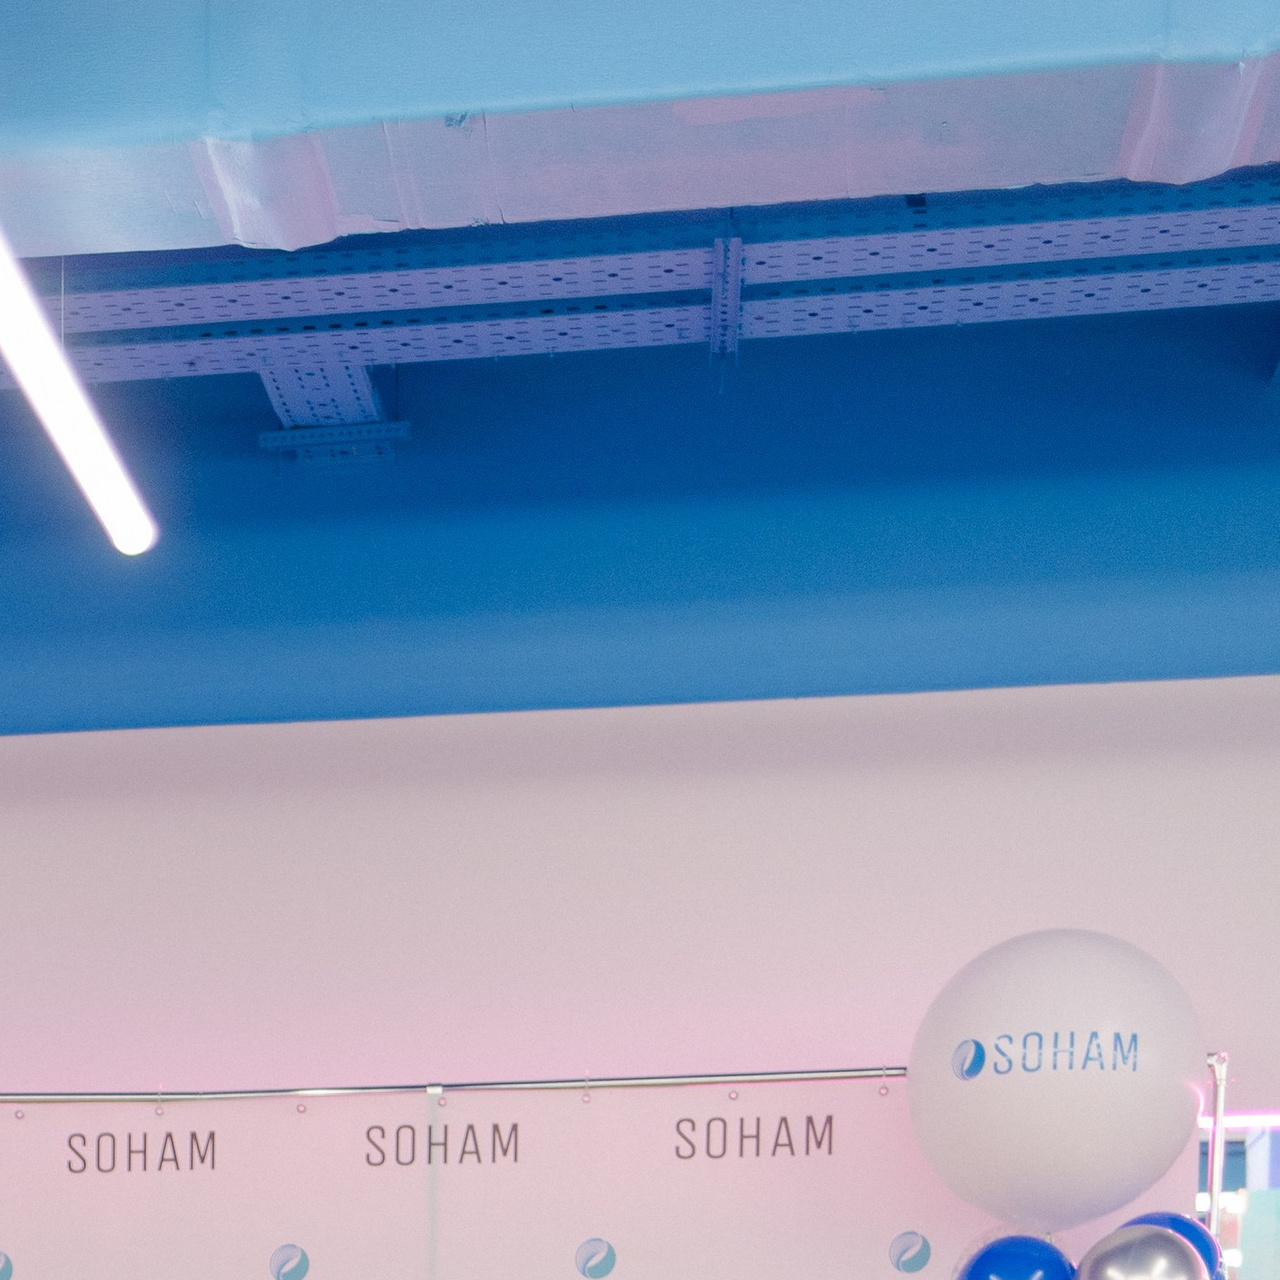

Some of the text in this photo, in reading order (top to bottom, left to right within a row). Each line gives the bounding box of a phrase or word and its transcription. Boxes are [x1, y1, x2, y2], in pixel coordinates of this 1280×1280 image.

[993, 1031, 1139, 1075] SOHAM
[66, 1130, 216, 1175] SOHAM
[365, 1122, 519, 1168] SOHAM
[674, 1114, 835, 1161] SOHAM
